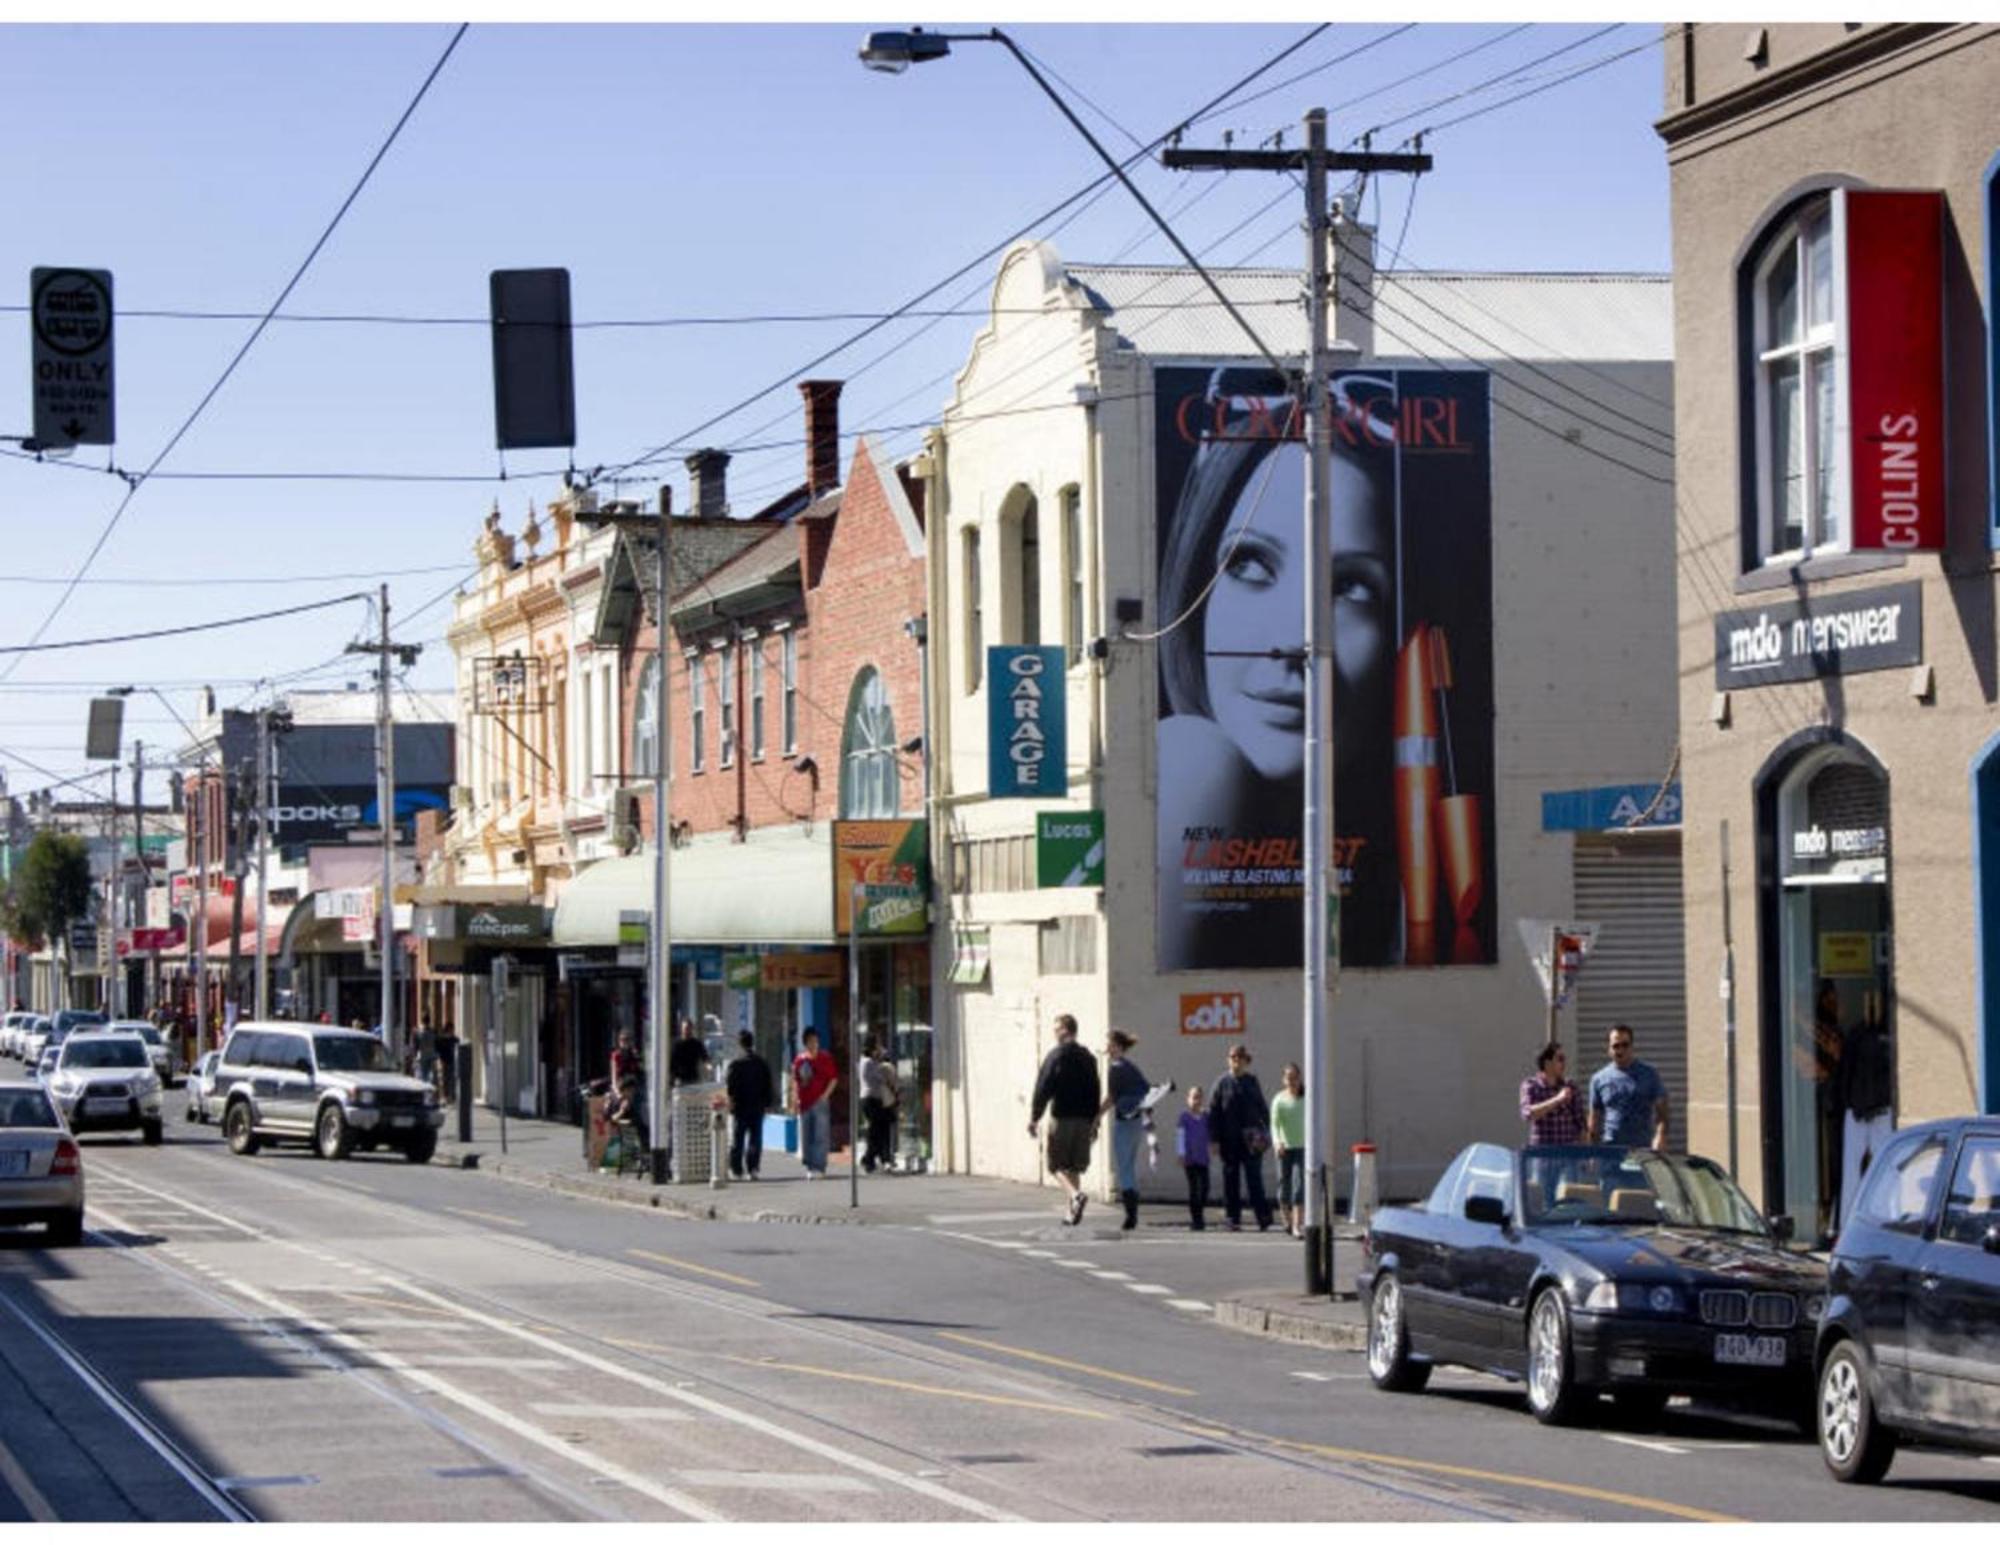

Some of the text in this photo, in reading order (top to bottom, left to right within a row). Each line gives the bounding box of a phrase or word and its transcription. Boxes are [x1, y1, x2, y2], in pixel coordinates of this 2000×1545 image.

[38, 361, 108, 381] ONLY
[1880, 414, 1919, 549] COLINS
[1730, 603, 1901, 664] mdo menswear
[1009, 654, 1045, 785] GARAGE
[1183, 827, 1224, 842] NEW
[1794, 824, 1828, 854] mdo
[1183, 838, 1367, 868] LASHBLST
[1232, 868, 1292, 884] BLASTING
[468, 923, 530, 937] macpac
